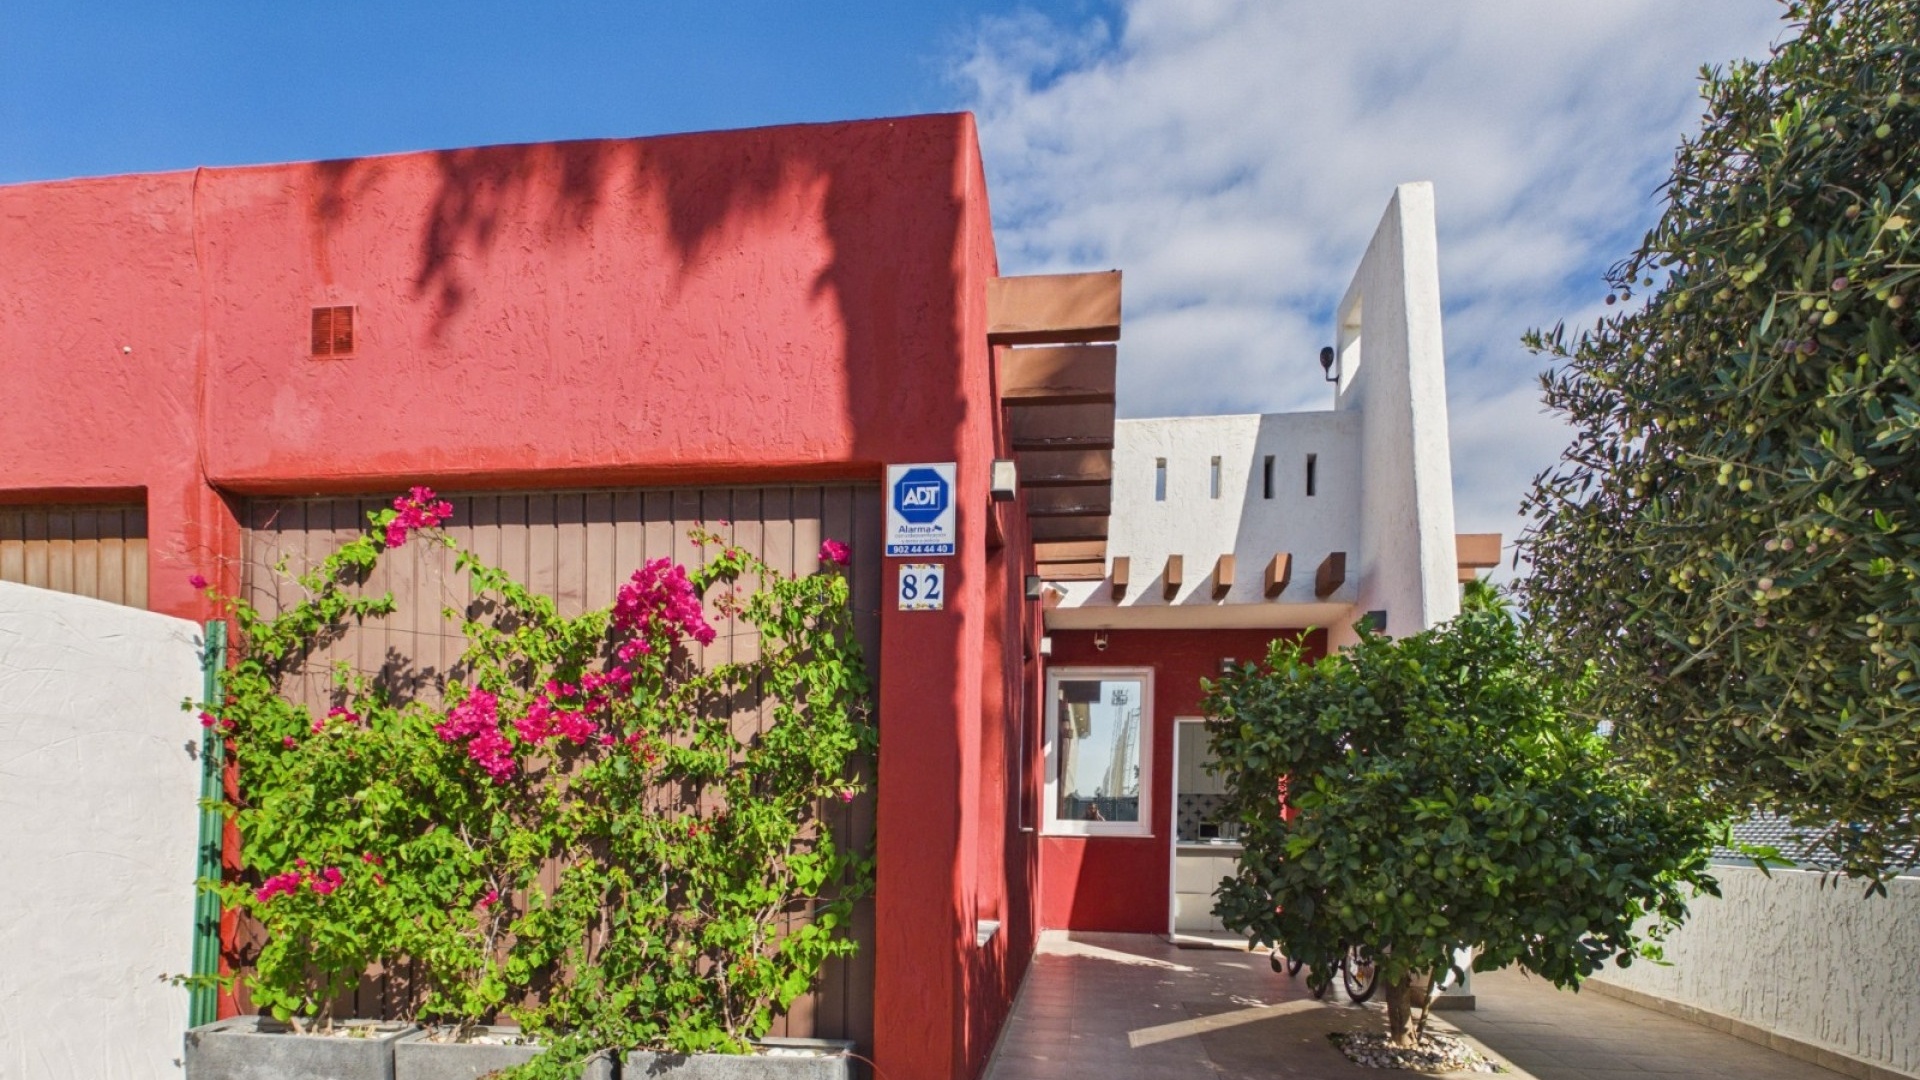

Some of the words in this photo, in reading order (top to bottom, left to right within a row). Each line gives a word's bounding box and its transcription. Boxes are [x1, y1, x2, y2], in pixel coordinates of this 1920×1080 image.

[903, 486, 939, 505] ADT
[899, 525, 931, 533] Alarma
[902, 574, 940, 600] 82
